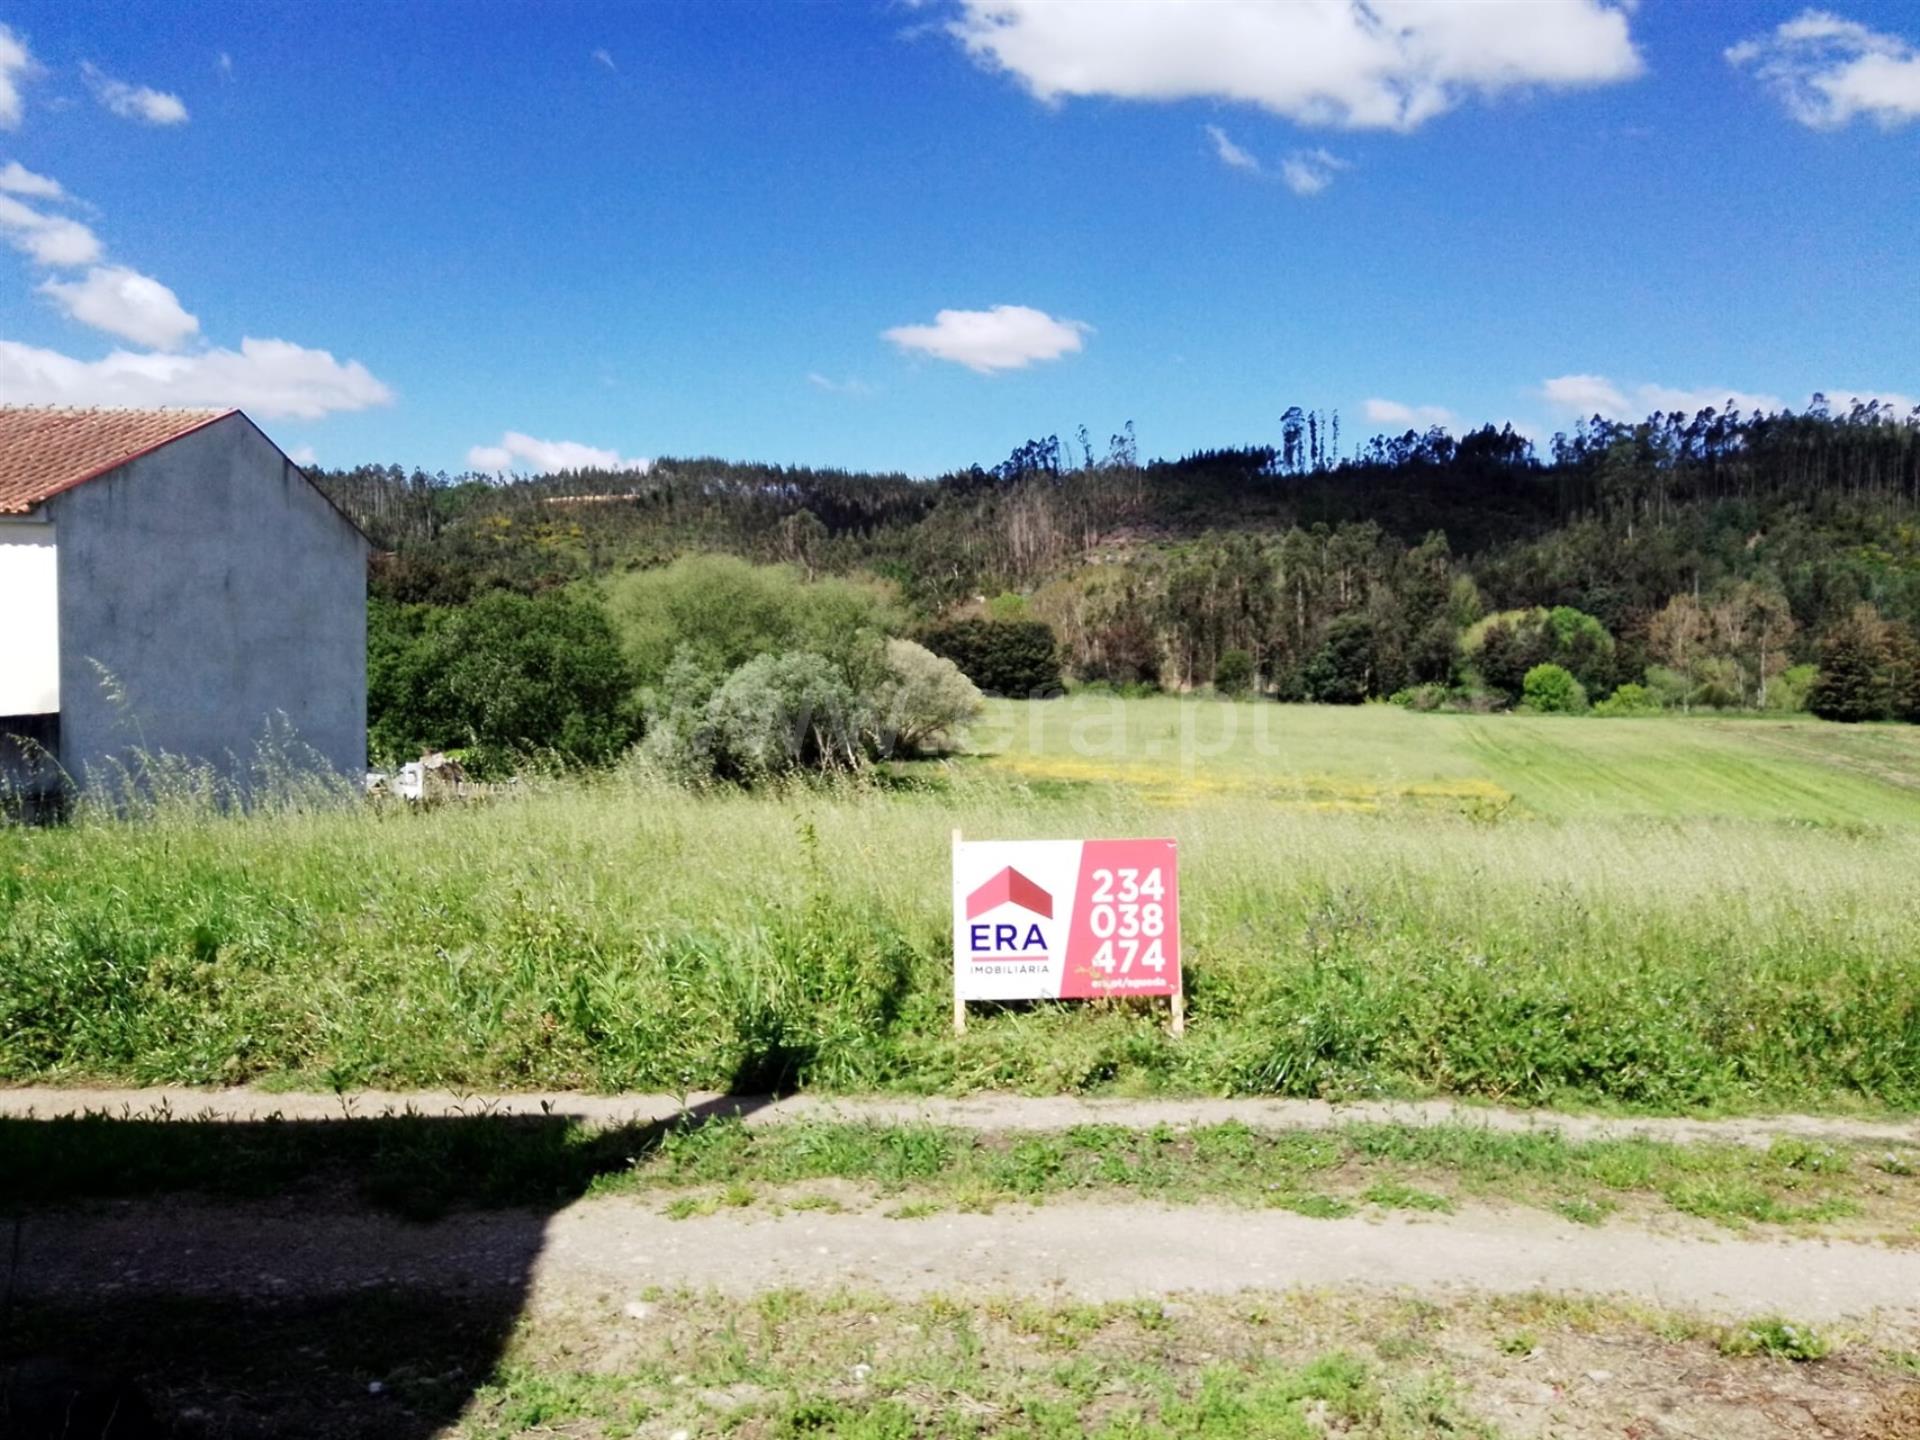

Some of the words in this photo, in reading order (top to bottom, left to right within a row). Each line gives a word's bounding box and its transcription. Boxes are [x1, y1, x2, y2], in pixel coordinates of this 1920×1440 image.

[1091, 867, 1165, 902] 234
[971, 923, 1048, 951] ERA
[1090, 903, 1164, 938] 038
[1091, 938, 1166, 974] 474
